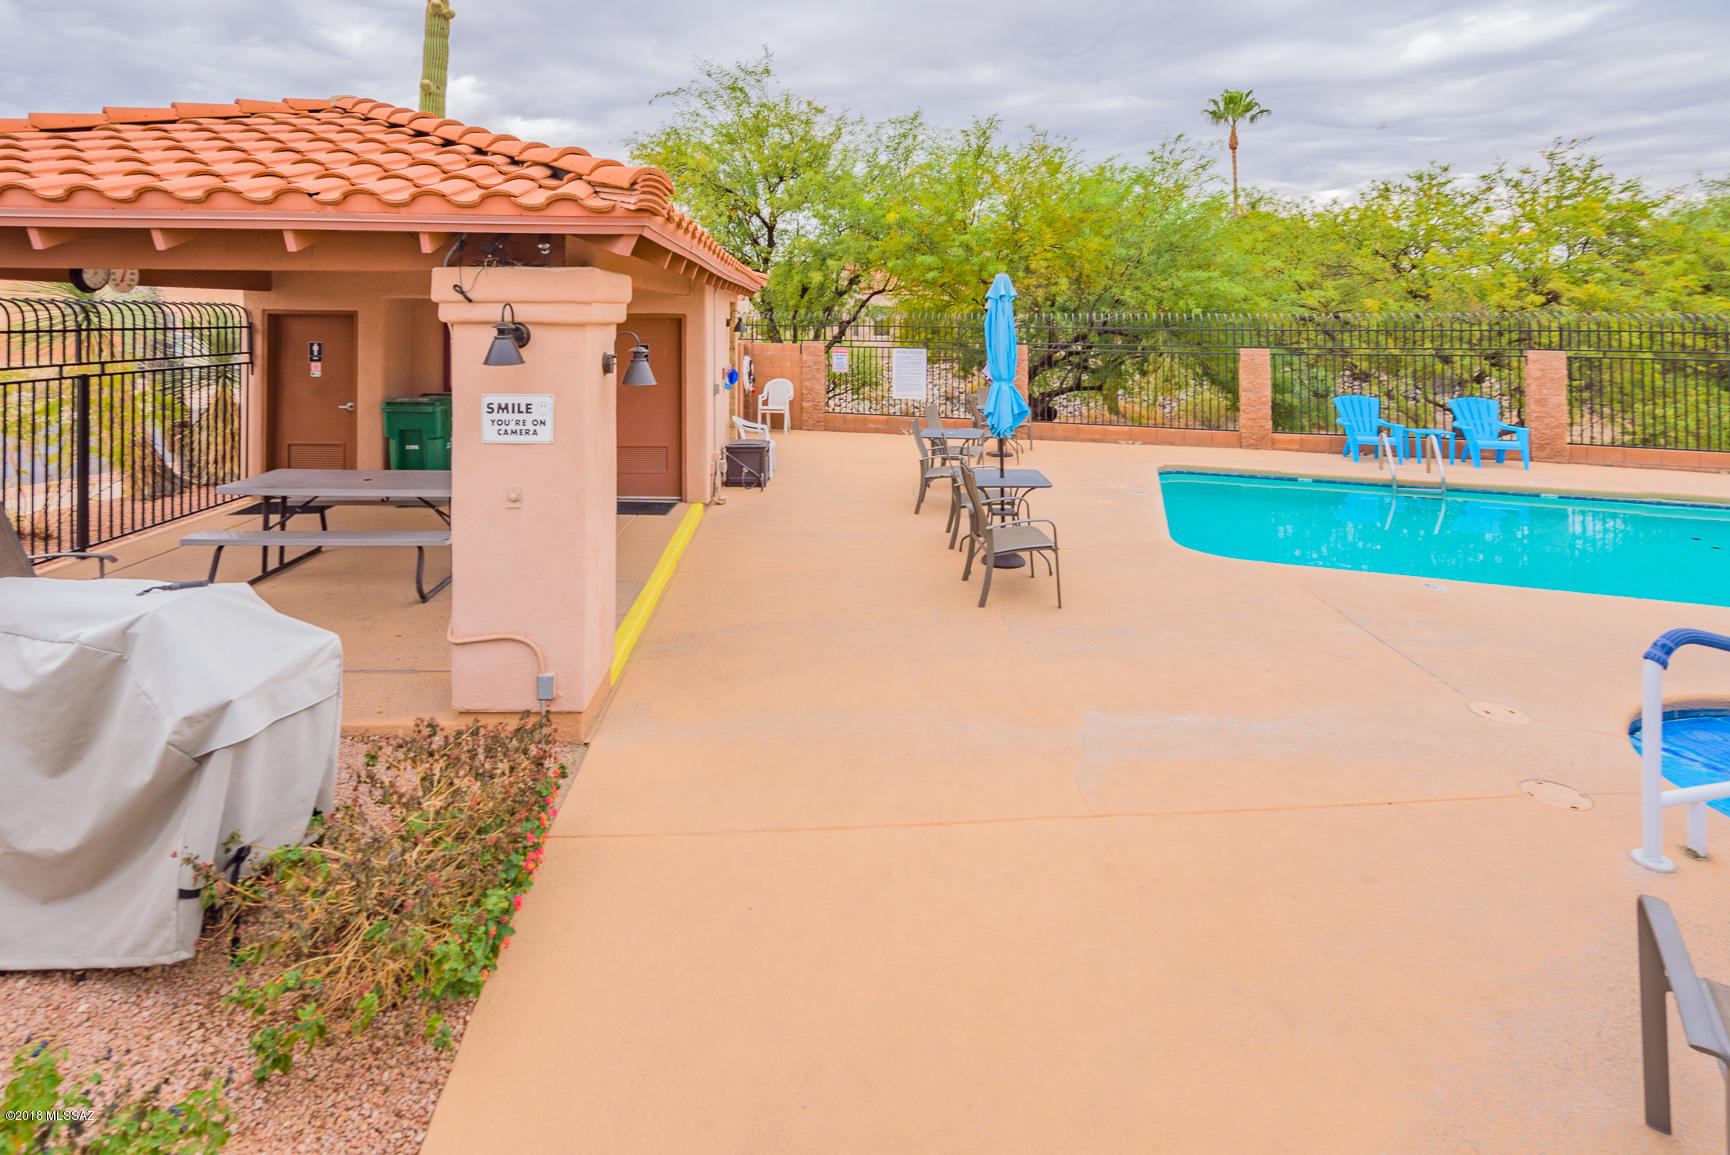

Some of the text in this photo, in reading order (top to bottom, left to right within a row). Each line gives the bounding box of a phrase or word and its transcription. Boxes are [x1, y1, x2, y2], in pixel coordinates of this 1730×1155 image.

[486, 402, 532, 414] SMILE
[490, 418, 546, 427] YOU'RE ON
[496, 428, 538, 436] CAMERA
